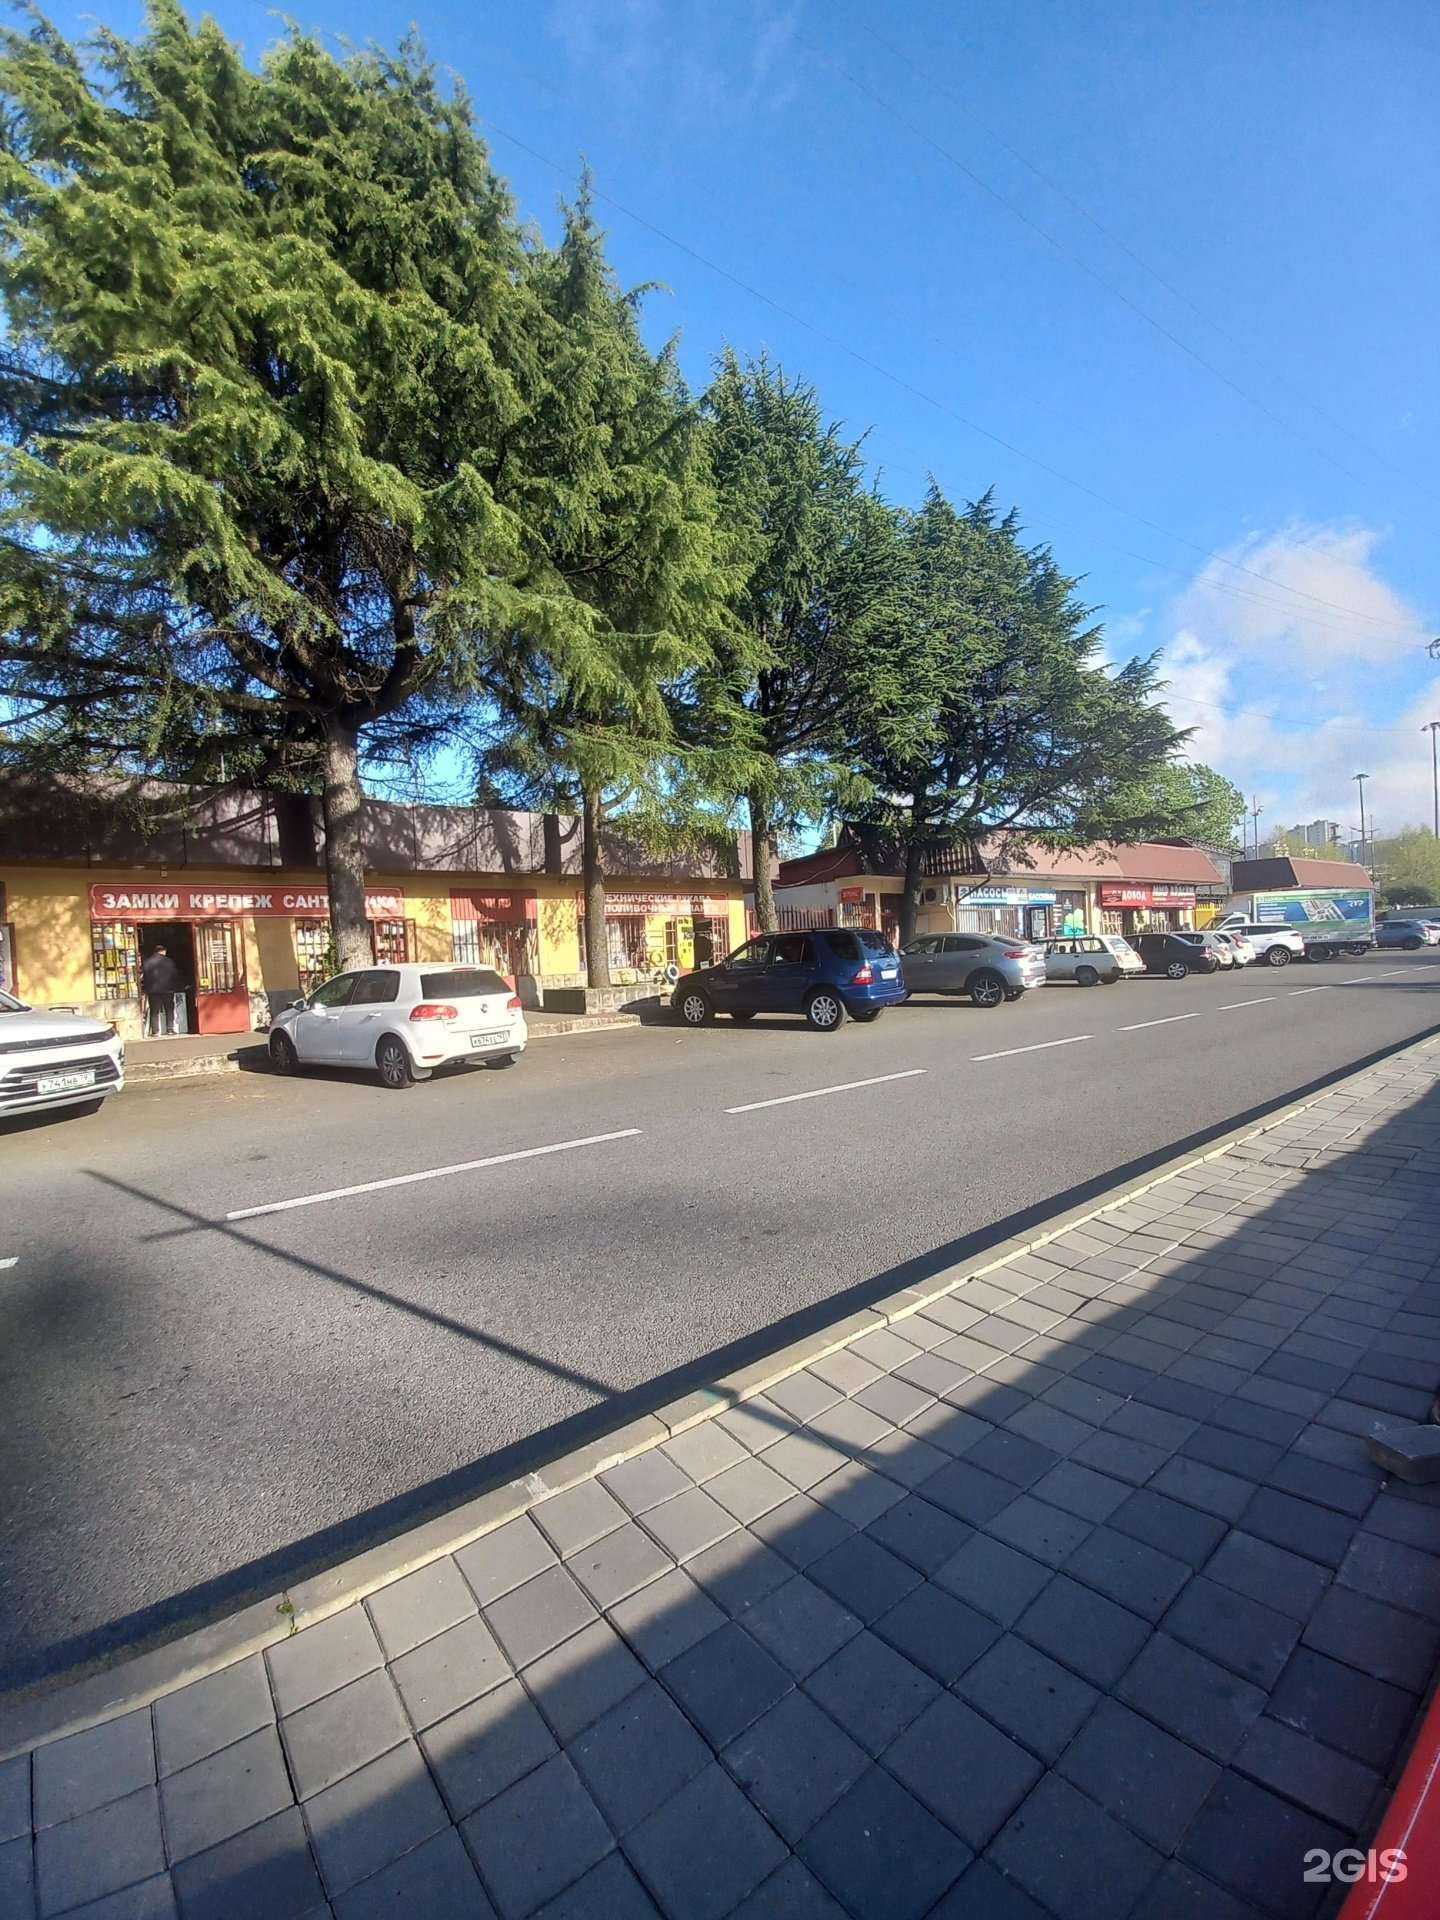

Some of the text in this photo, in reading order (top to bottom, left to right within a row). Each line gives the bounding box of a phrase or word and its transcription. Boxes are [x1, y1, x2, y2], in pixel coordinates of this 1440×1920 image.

[102, 893, 398, 909] ЗАМКИ КРЕПЕЖ САНТИКА
[605, 894, 673, 903] ЕХНИЧЕСКИЕ
